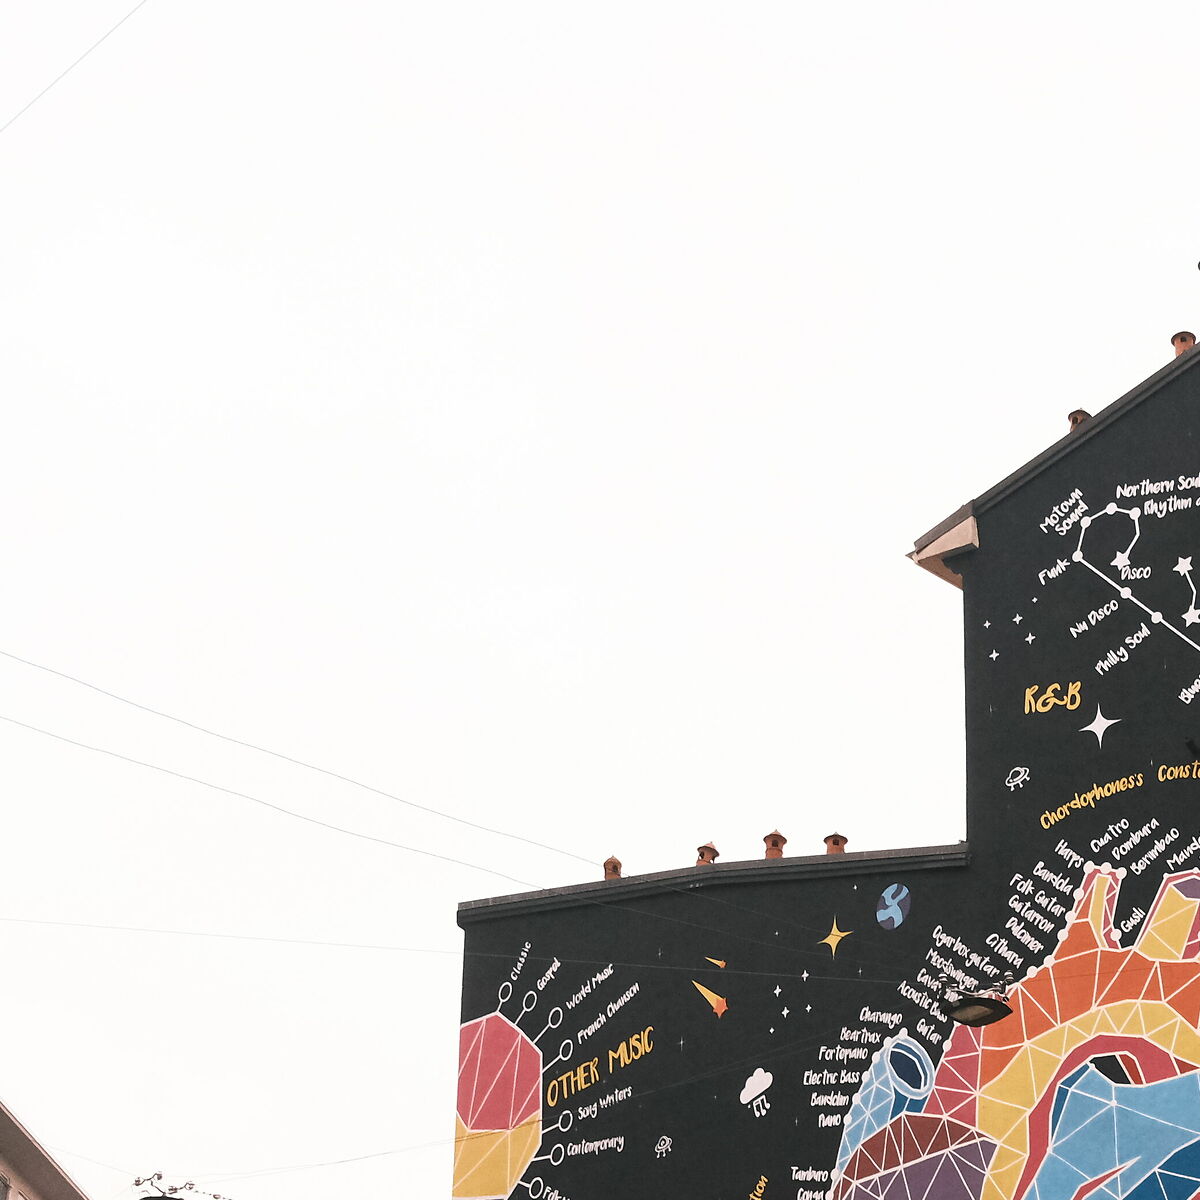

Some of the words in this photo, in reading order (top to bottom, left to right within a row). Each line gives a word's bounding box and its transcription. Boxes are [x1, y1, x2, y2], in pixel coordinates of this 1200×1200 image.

[1116, 478, 1174, 498] Northern
[1144, 494, 1192, 518] Rhythm
[1024, 680, 1081, 714] R&B
[510, 941, 532, 981] Classic
[565, 978, 591, 1010] World
[591, 963, 614, 990] Music
[577, 1011, 607, 1045] French
[606, 982, 640, 1018] Chanson
[547, 1057, 599, 1107] OTHER
[608, 1026, 654, 1074] MUSIC
[803, 1069, 839, 1085] Electric
[840, 1069, 861, 1084] Bass
